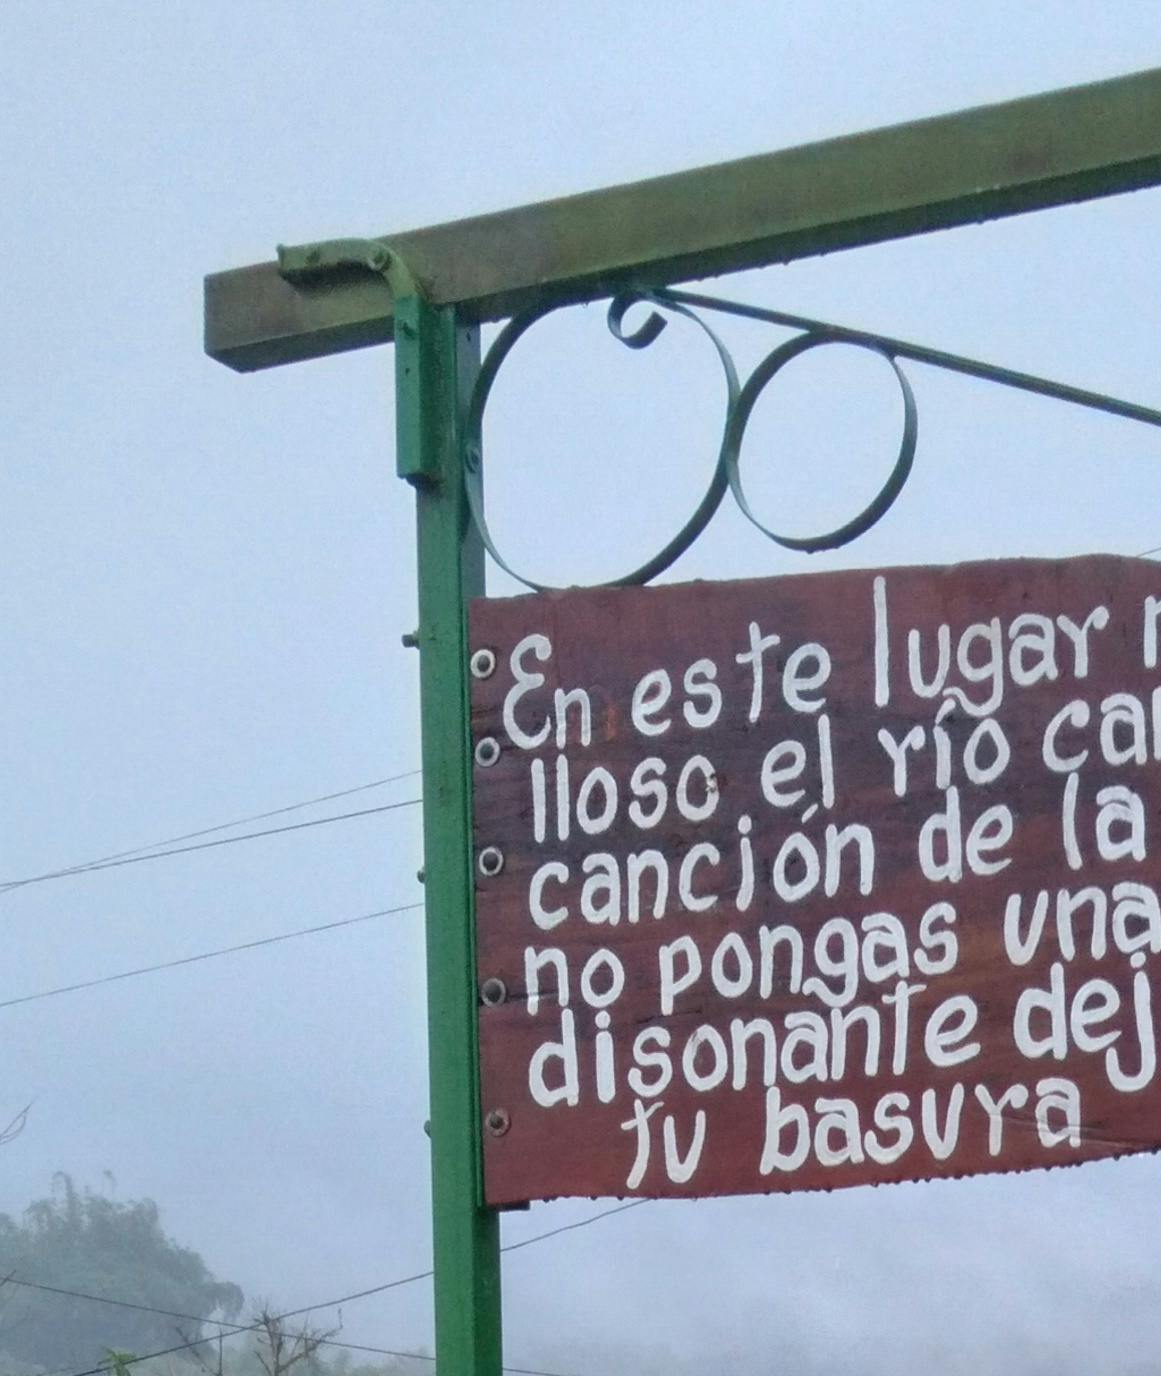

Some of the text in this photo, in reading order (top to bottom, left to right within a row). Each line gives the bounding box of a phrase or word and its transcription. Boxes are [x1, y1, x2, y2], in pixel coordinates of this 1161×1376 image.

[503, 634, 591, 749] En
[631, 622, 831, 736] este
[873, 576, 1109, 719] lugar
[531, 754, 719, 843] lloso
[761, 714, 835, 809] el
[878, 698, 1010, 798] río
[529, 804, 875, 930] canción
[919, 786, 1013, 883] de
[1063, 772, 1146, 870] la
[524, 946, 625, 1016] no
[659, 902, 958, 1016] pongas
[529, 980, 981, 1107] disonante
[621, 1077, 1081, 1189] tu basura
